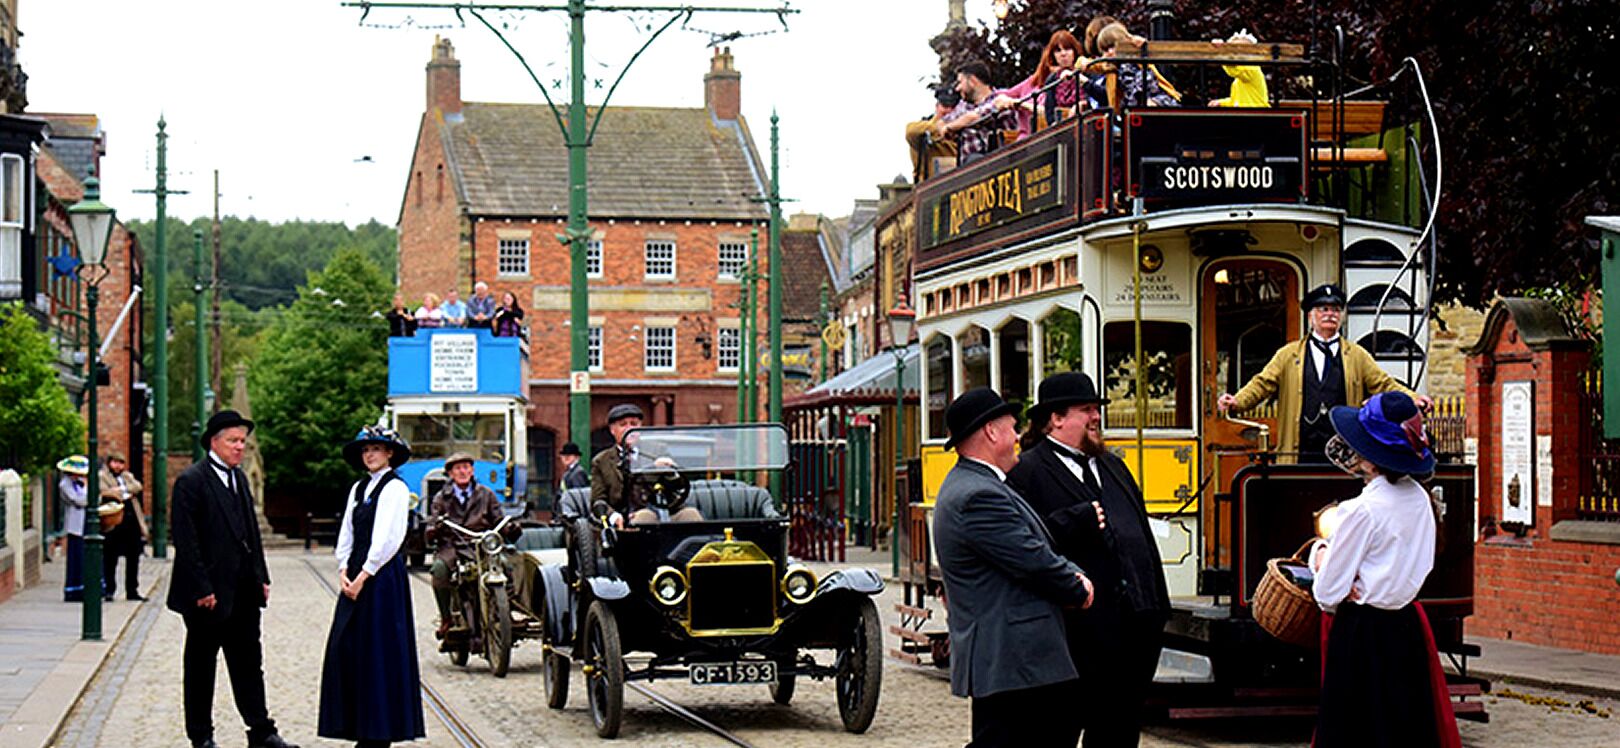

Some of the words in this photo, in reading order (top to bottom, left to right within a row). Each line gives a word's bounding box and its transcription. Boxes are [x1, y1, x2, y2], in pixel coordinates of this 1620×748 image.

[1164, 166, 1273, 189] SCOTSWOOD
[950, 178, 995, 235] RINGTONS
[997, 168, 1023, 214] TEA
[575, 374, 584, 390] F
